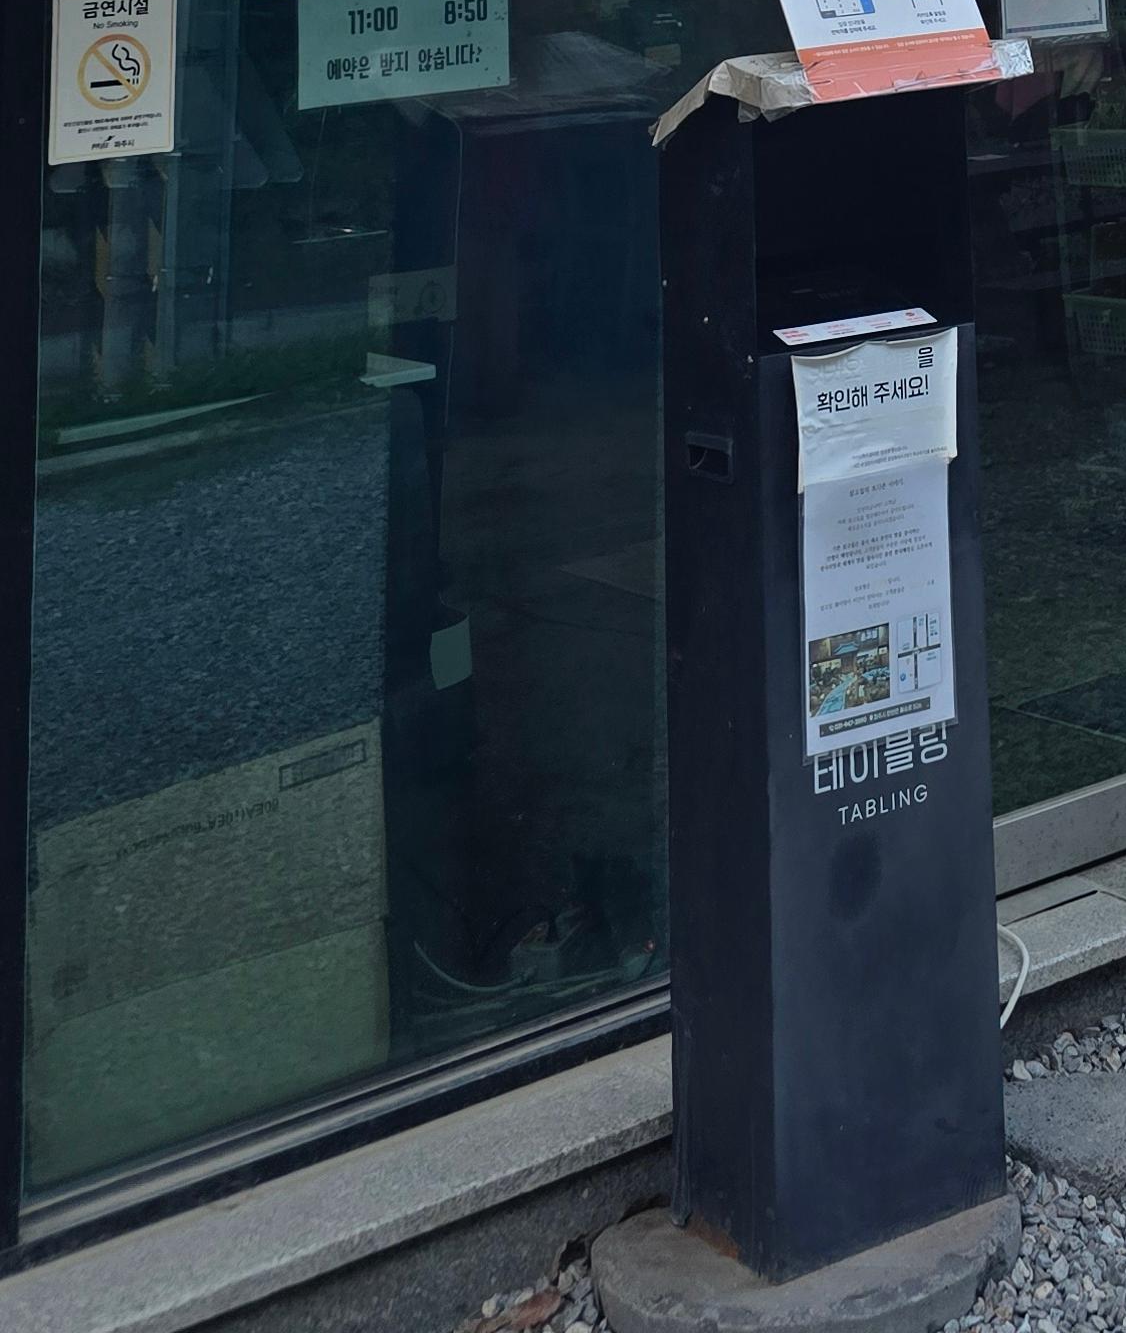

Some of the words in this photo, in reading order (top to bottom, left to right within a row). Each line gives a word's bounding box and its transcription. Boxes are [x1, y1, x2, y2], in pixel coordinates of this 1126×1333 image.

[92, 21, 105, 30] No
[106, 19, 139, 30] Smoking
[348, 5, 399, 35] 11:00
[326, 55, 371, 81] 예약은
[379, 50, 409, 77] 받지
[917, 346, 933, 369] 을
[817, 385, 868, 413] 확인해
[873, 374, 929, 404] 주세요!
[837, 784, 928, 825] TABLING
